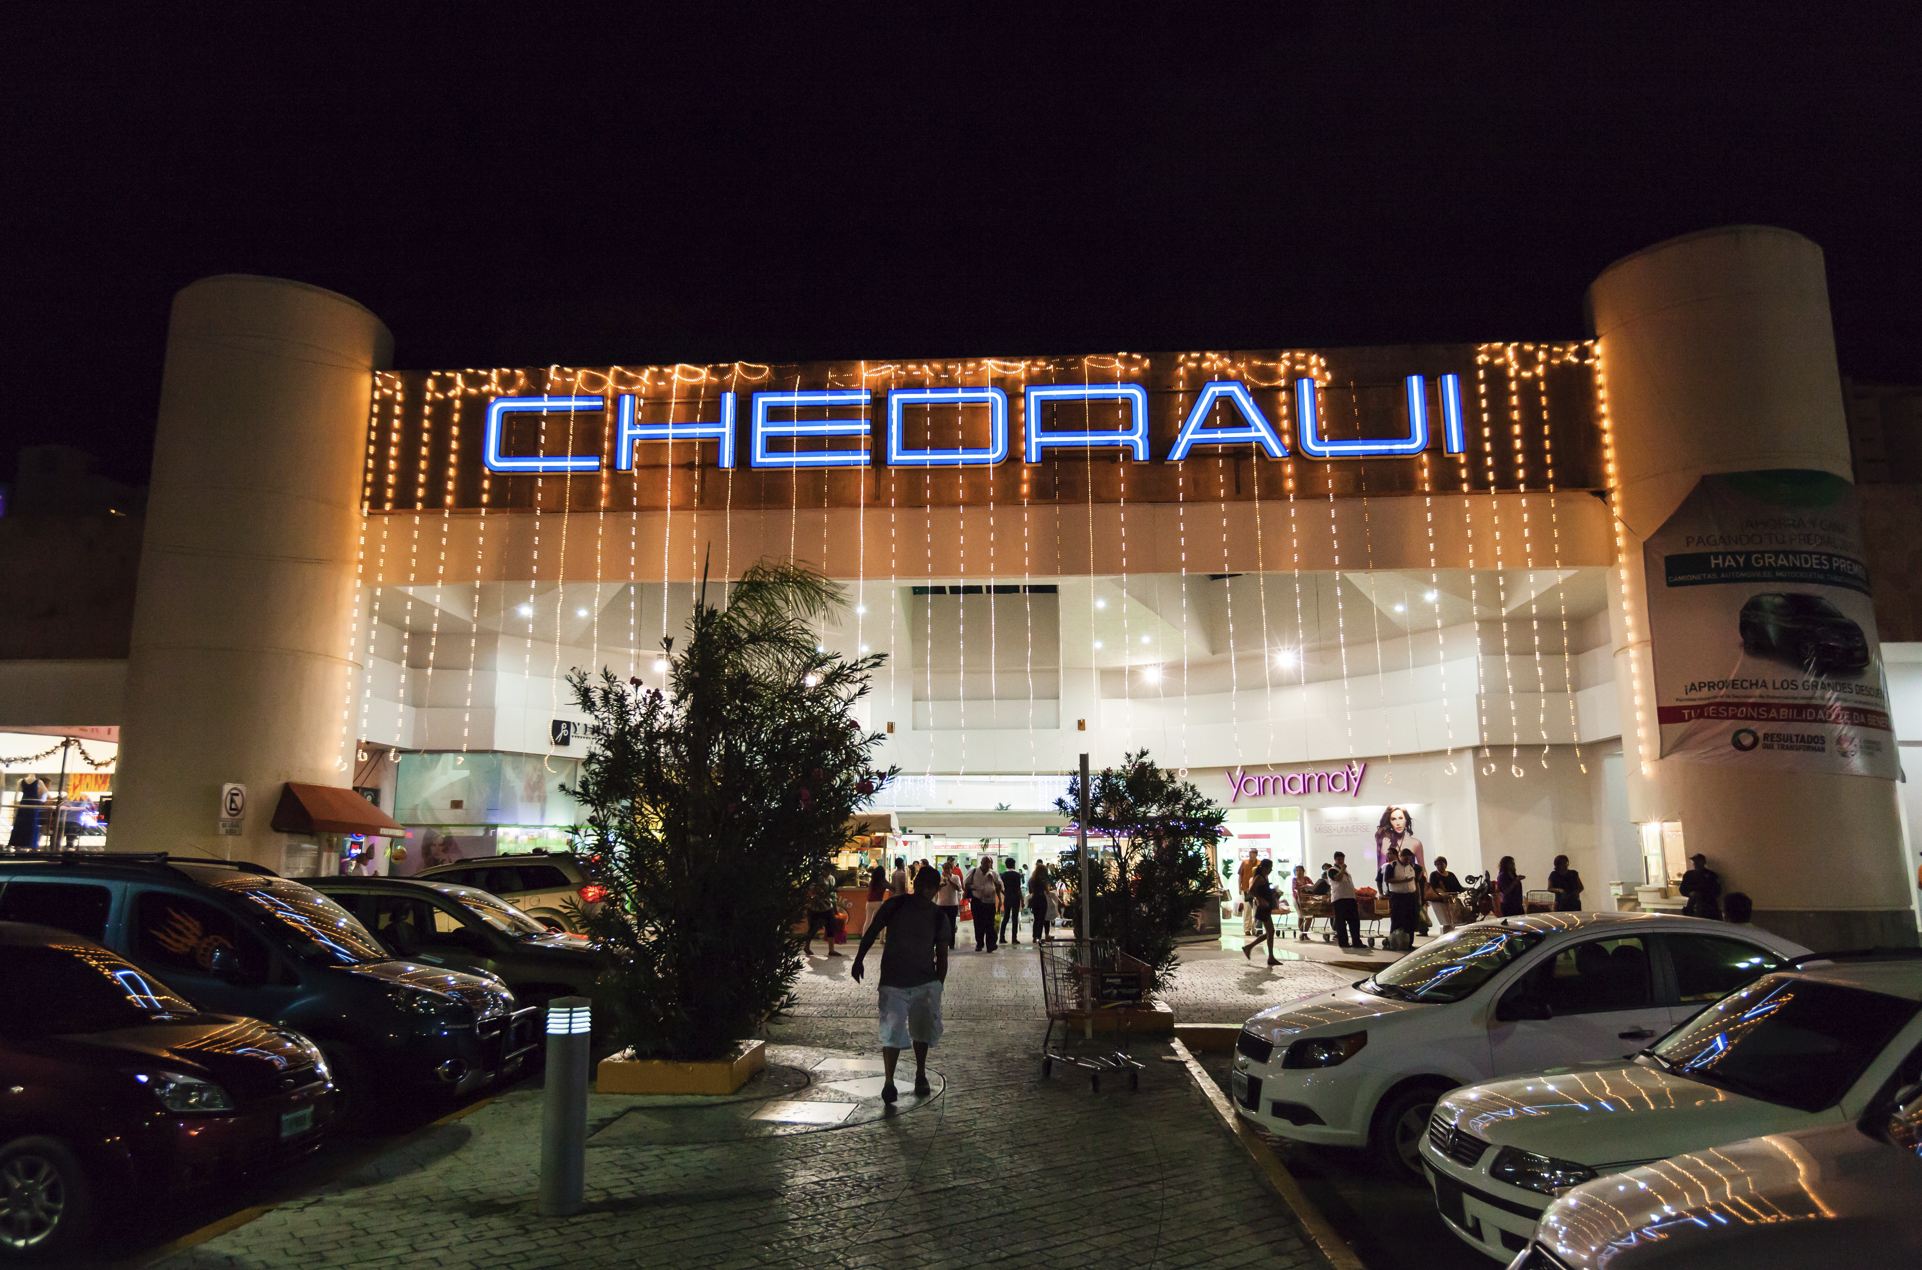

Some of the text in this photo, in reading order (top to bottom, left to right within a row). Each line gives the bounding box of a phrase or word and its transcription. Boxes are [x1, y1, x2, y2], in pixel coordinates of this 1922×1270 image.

[484, 374, 1466, 473] CHEDRAUI
[1685, 534, 1763, 547] PAGANDO
[1710, 554, 1746, 568] HAY
[1751, 553, 1830, 570] GRANDES
[1684, 679, 1769, 696] ¡APROVECHA
[1772, 679, 1799, 691] LOS
[1801, 680, 1853, 694] GRANDES
[1763, 733, 1826, 745] RESULTADOS
